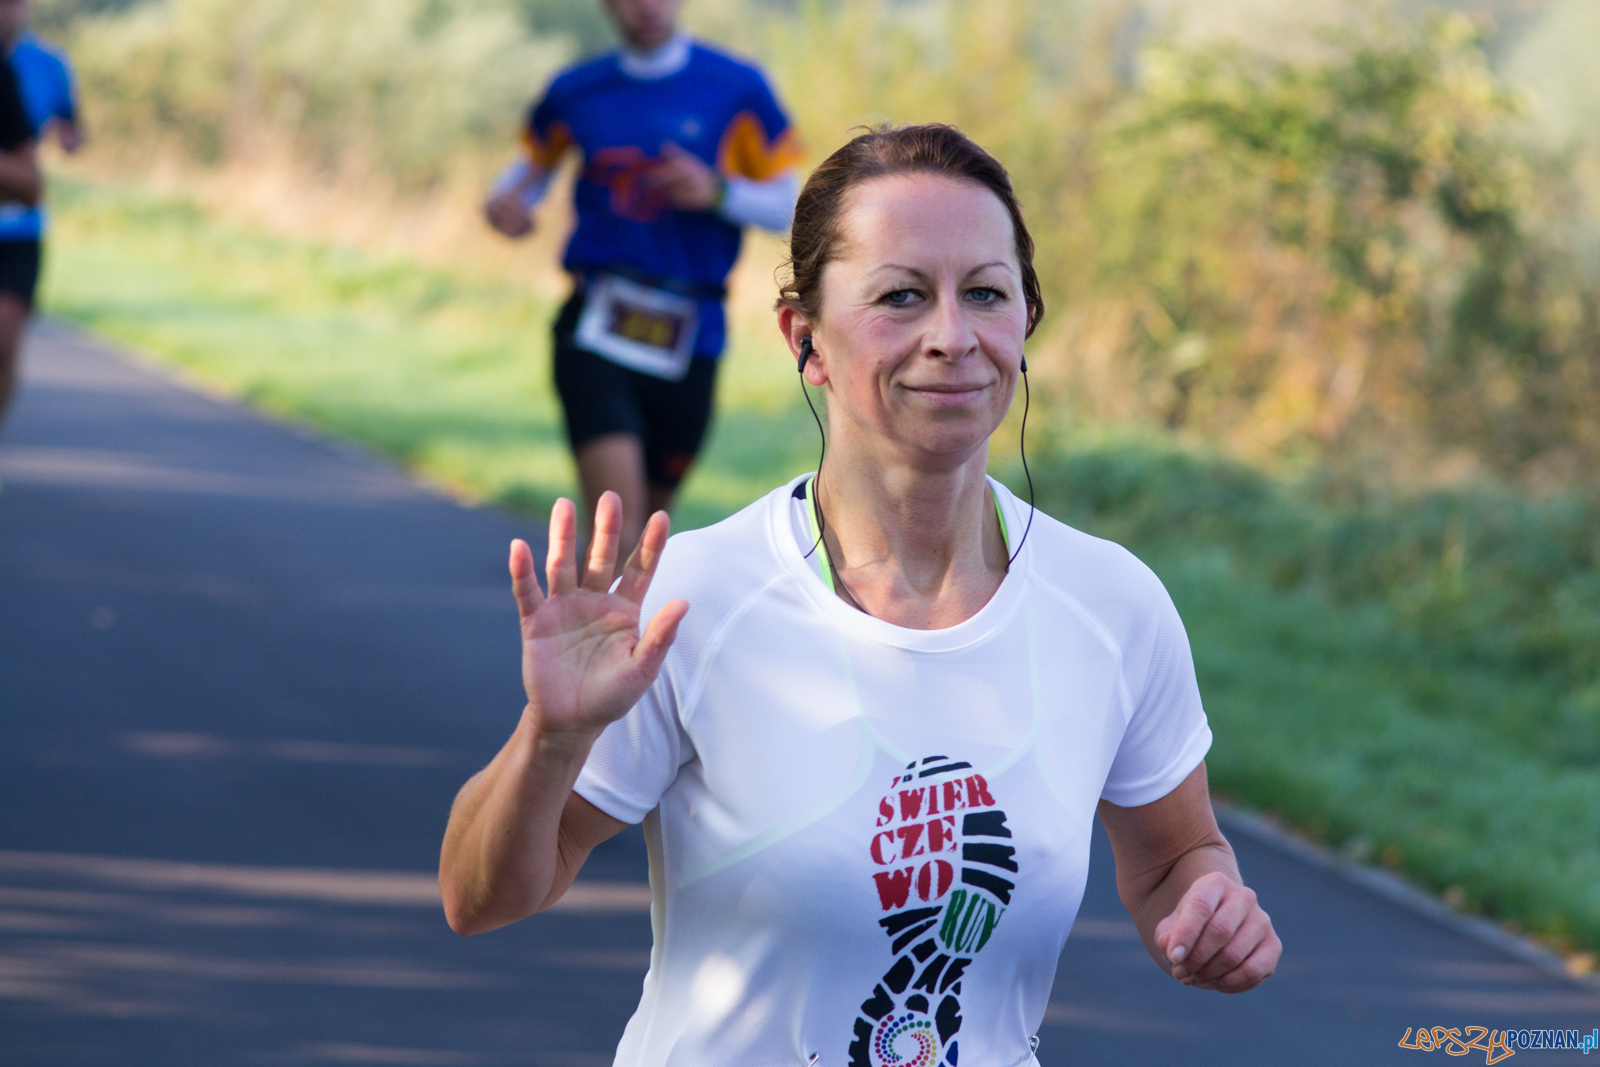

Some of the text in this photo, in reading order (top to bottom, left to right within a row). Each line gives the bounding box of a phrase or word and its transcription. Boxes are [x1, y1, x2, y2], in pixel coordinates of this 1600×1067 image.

[876, 774, 996, 827] ŚWIER
[870, 815, 957, 865] CZE
[872, 859, 953, 911] WO
[939, 888, 1006, 953] RUN
